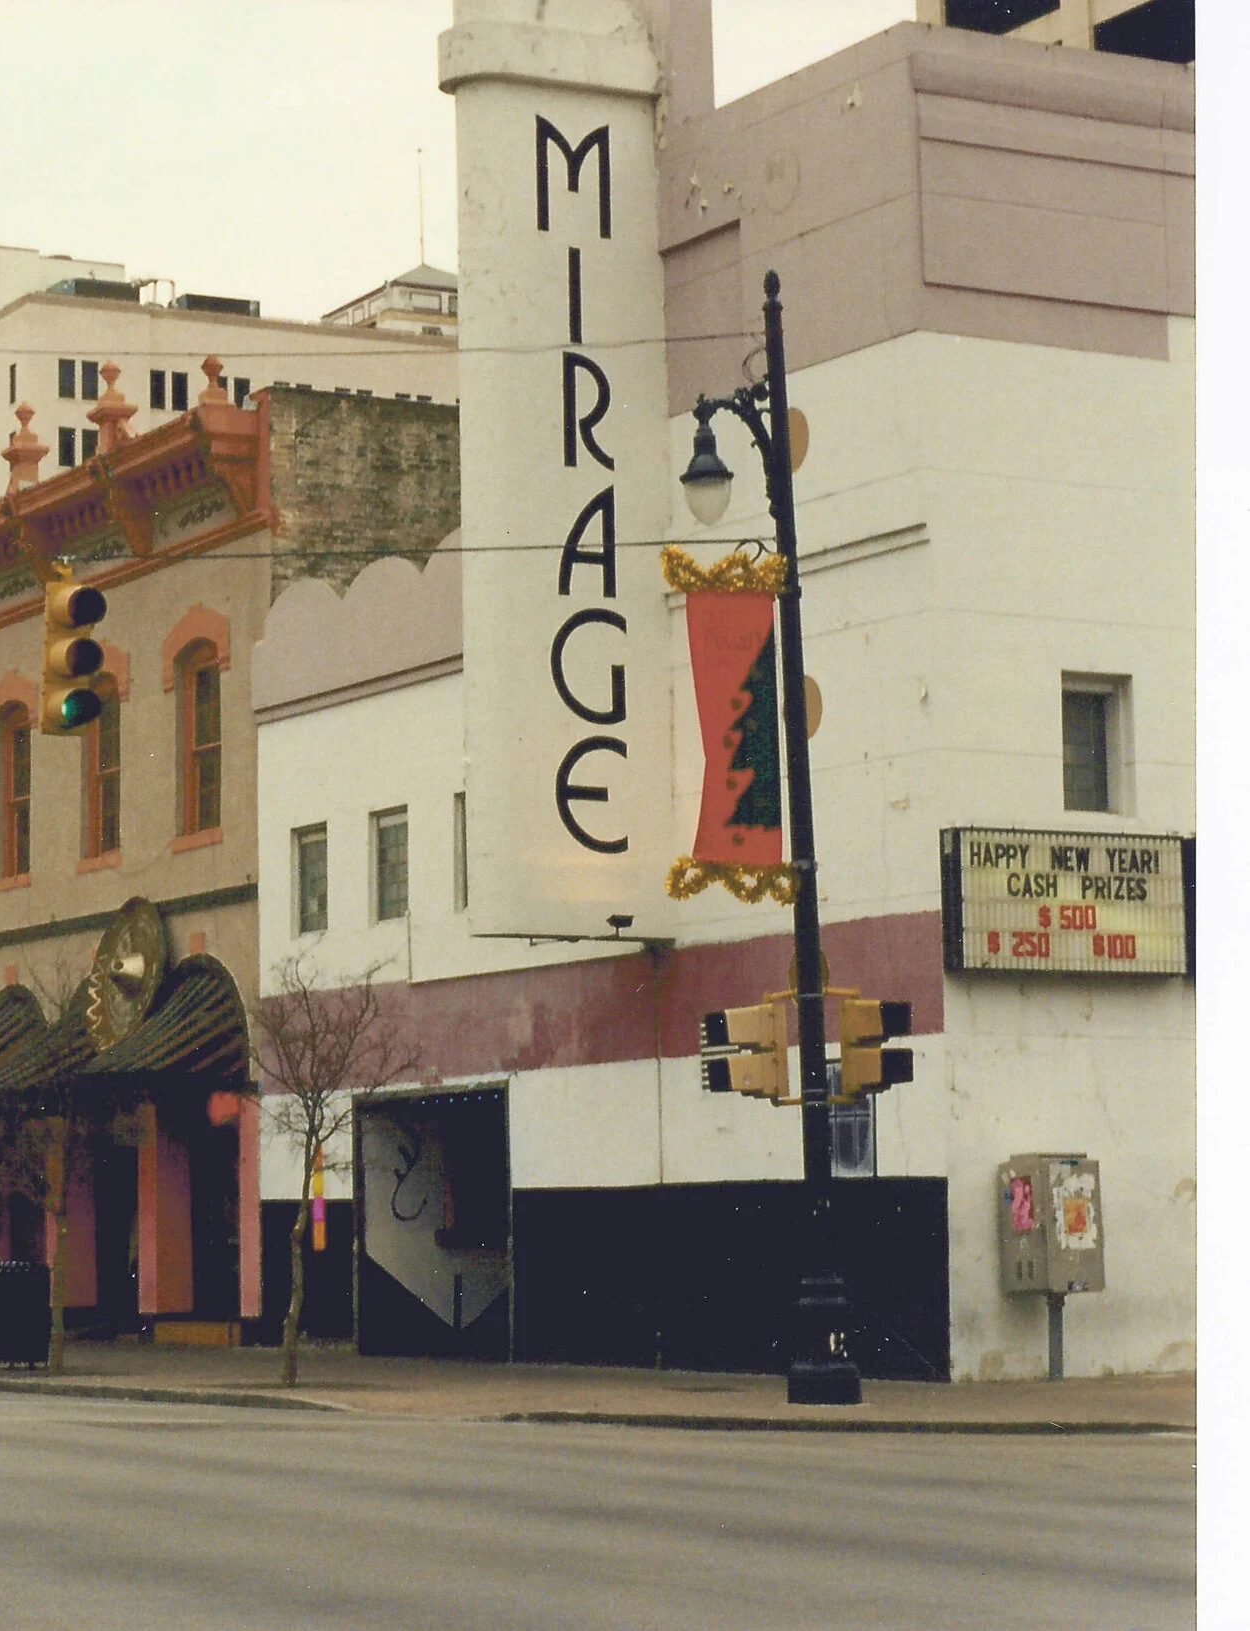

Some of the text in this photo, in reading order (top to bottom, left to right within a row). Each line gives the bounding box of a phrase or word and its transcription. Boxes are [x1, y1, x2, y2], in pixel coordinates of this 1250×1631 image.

[535, 114, 629, 854] MIRAGE
[969, 841, 1160, 875] HAPPY NEW YEAR!
[1006, 872, 1148, 901] CASH PRIZES
